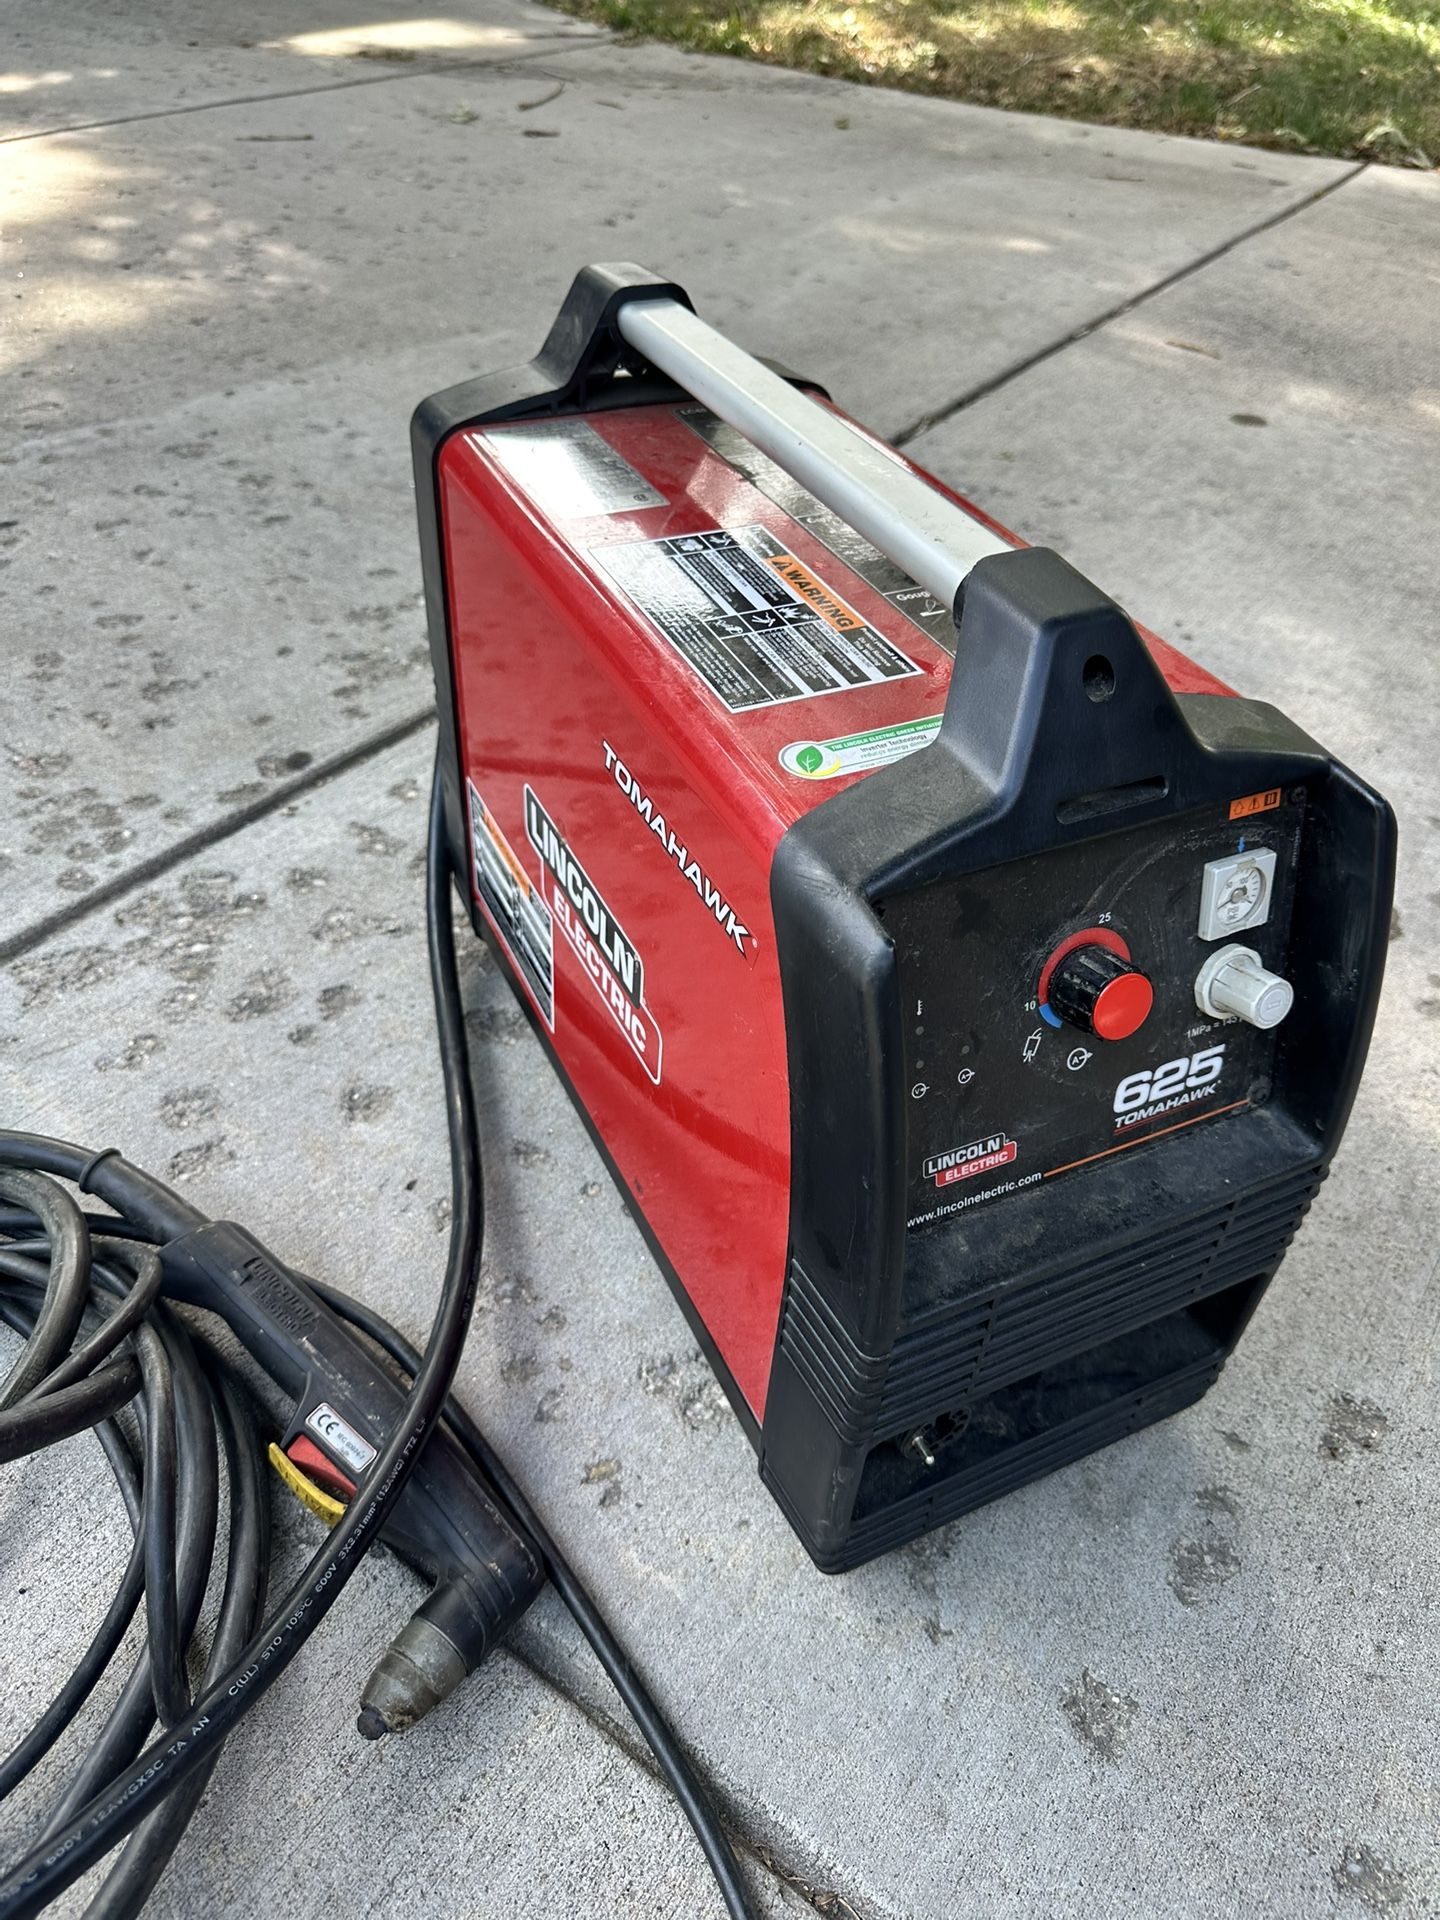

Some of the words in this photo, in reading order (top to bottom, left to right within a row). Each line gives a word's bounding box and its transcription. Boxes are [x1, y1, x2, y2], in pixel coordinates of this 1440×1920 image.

[784, 570, 855, 627] WARNING
[843, 738, 868, 748] LINCOLN
[869, 731, 896, 743] ELECTRIC
[896, 727, 916, 737] GREEN
[860, 742, 888, 753] Inverter
[888, 733, 927, 747] Technology
[602, 740, 749, 953] TOMAHAWK
[531, 802, 636, 993] LINCOLN
[1099, 912, 1112, 924] 25
[553, 886, 646, 1052] ELECTRIC
[1024, 1000, 1036, 1012] 10
[1185, 1022, 1212, 1039] 1MPa
[1113, 1043, 1226, 1114] 625
[1114, 1084, 1217, 1128] TOMAHAWK
[928, 1136, 1001, 1174] LINCOLN
[945, 1150, 1009, 1182] ELECTRIC
[906, 1171, 1042, 1228] www.lincolnelectric.com
[317, 1414, 339, 1436] CE
[46, 1830, 82, 1866] 600V
[168, 1740, 187, 1756] TA
[191, 1715, 211, 1736] AN
[228, 1664, 260, 1697] C(UL)
[261, 1635, 282, 1660] STO
[315, 1563, 338, 1593] 600V
[376, 1458, 406, 1502] (12AWG)
[402, 1435, 419, 1456] FT2
